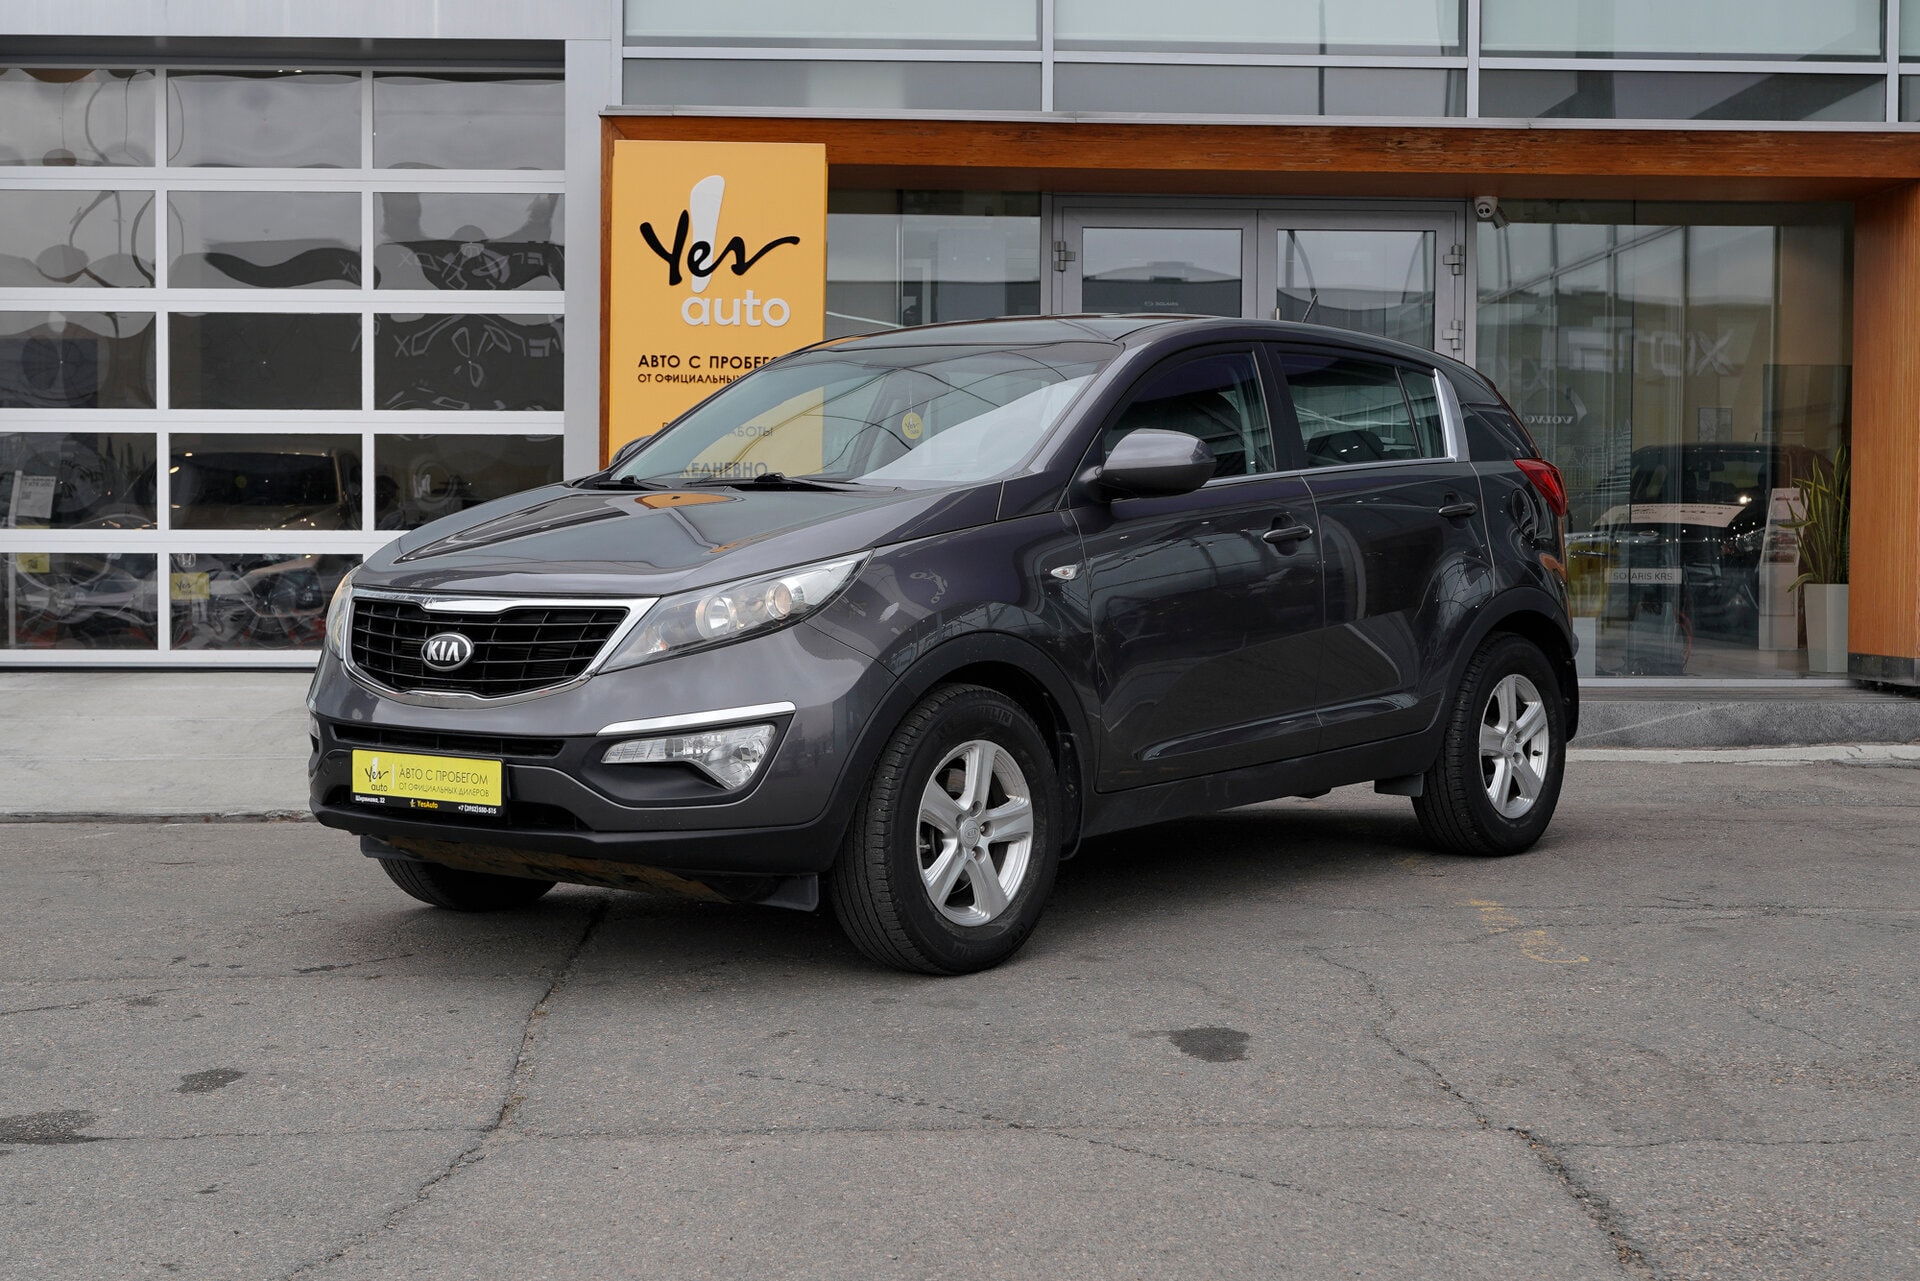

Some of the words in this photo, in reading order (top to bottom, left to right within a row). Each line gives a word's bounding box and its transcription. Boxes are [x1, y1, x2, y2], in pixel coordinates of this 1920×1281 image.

[639, 209, 801, 286] Yes
[681, 290, 792, 327] auto
[638, 355, 681, 368] АВТО
[689, 355, 701, 369] С
[709, 355, 778, 369] ПРОБЕГ
[638, 374, 652, 384] ОТ
[655, 374, 740, 385] ОФИЦИАЛЬНЫ
[1613, 572, 1652, 580] SOARIS
[1654, 572, 1673, 580] KRS
[427, 641, 460, 662] KIA
[364, 765, 389, 783] Yes
[399, 768, 423, 780] АВТО
[425, 769, 433, 781] С
[435, 770, 489, 785] ПРОБЕГОМ
[371, 783, 388, 792] auto
[399, 783, 407, 791] ОТ
[408, 783, 457, 795] ОФИЦИАЛЬНЫХ
[458, 787, 490, 797] ДИЛЕРОВ
[417, 800, 439, 809] YesAuto
